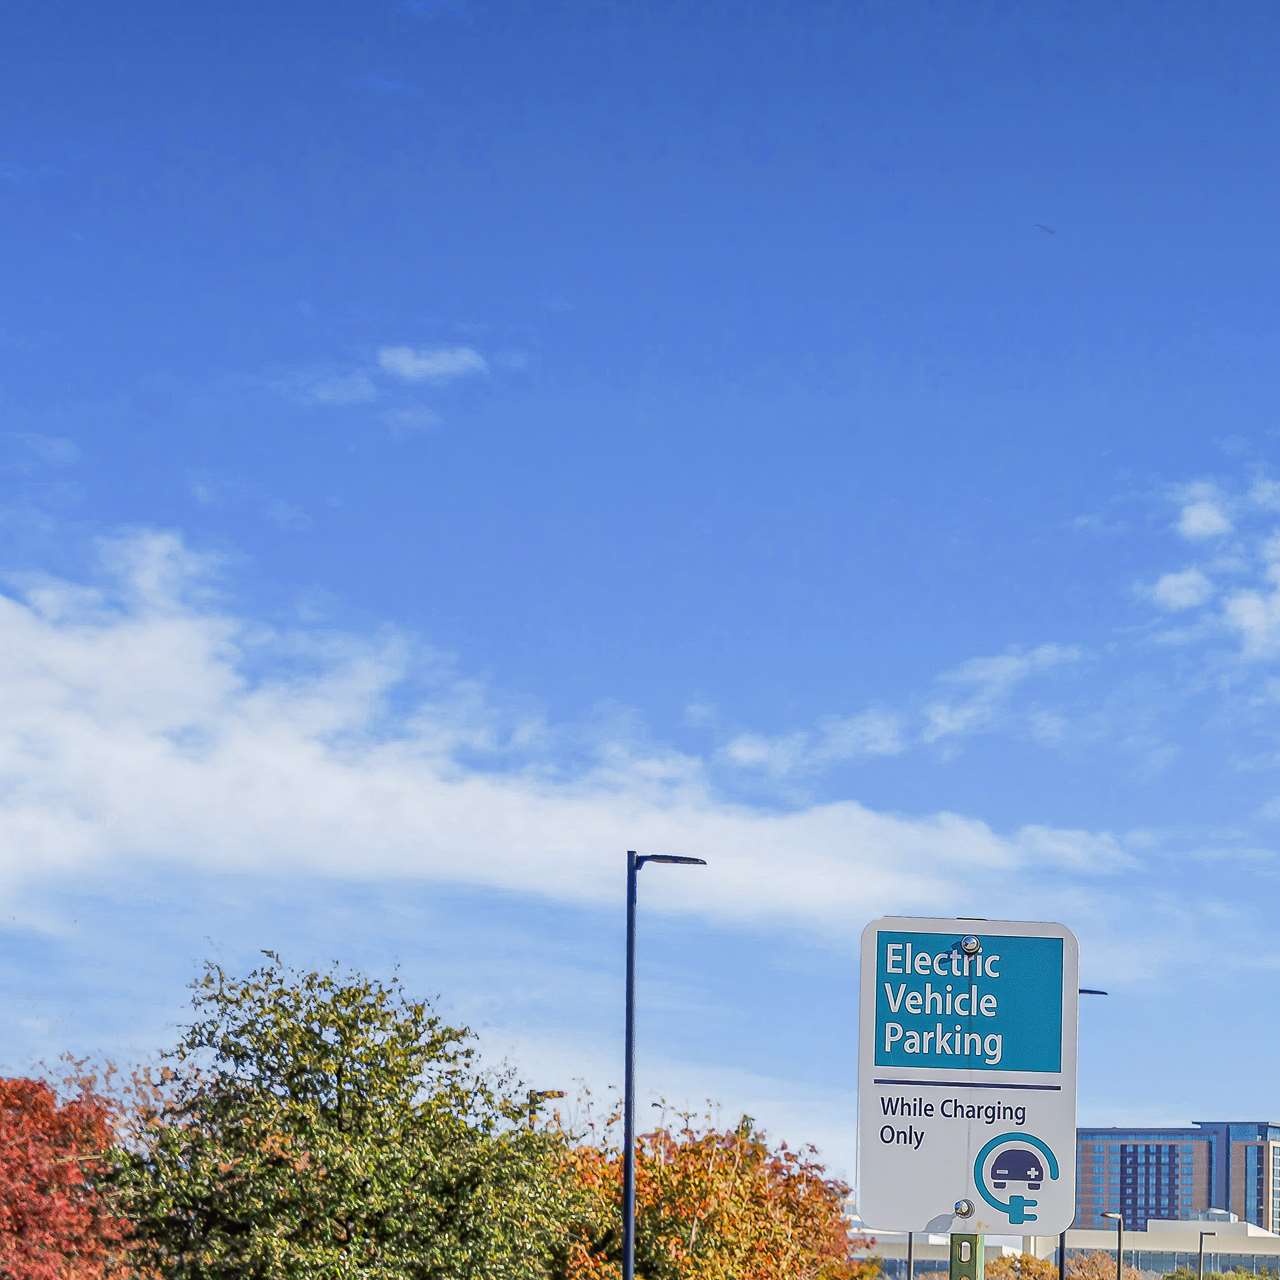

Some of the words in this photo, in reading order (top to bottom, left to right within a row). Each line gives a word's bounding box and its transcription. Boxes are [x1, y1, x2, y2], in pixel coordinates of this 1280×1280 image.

[886, 943, 1001, 978] Electric
[884, 983, 998, 1017] Vehicle
[884, 1022, 1003, 1065] Parking
[880, 1096, 935, 1117] While
[940, 1098, 1027, 1125] Charging
[879, 1124, 925, 1150] Only
